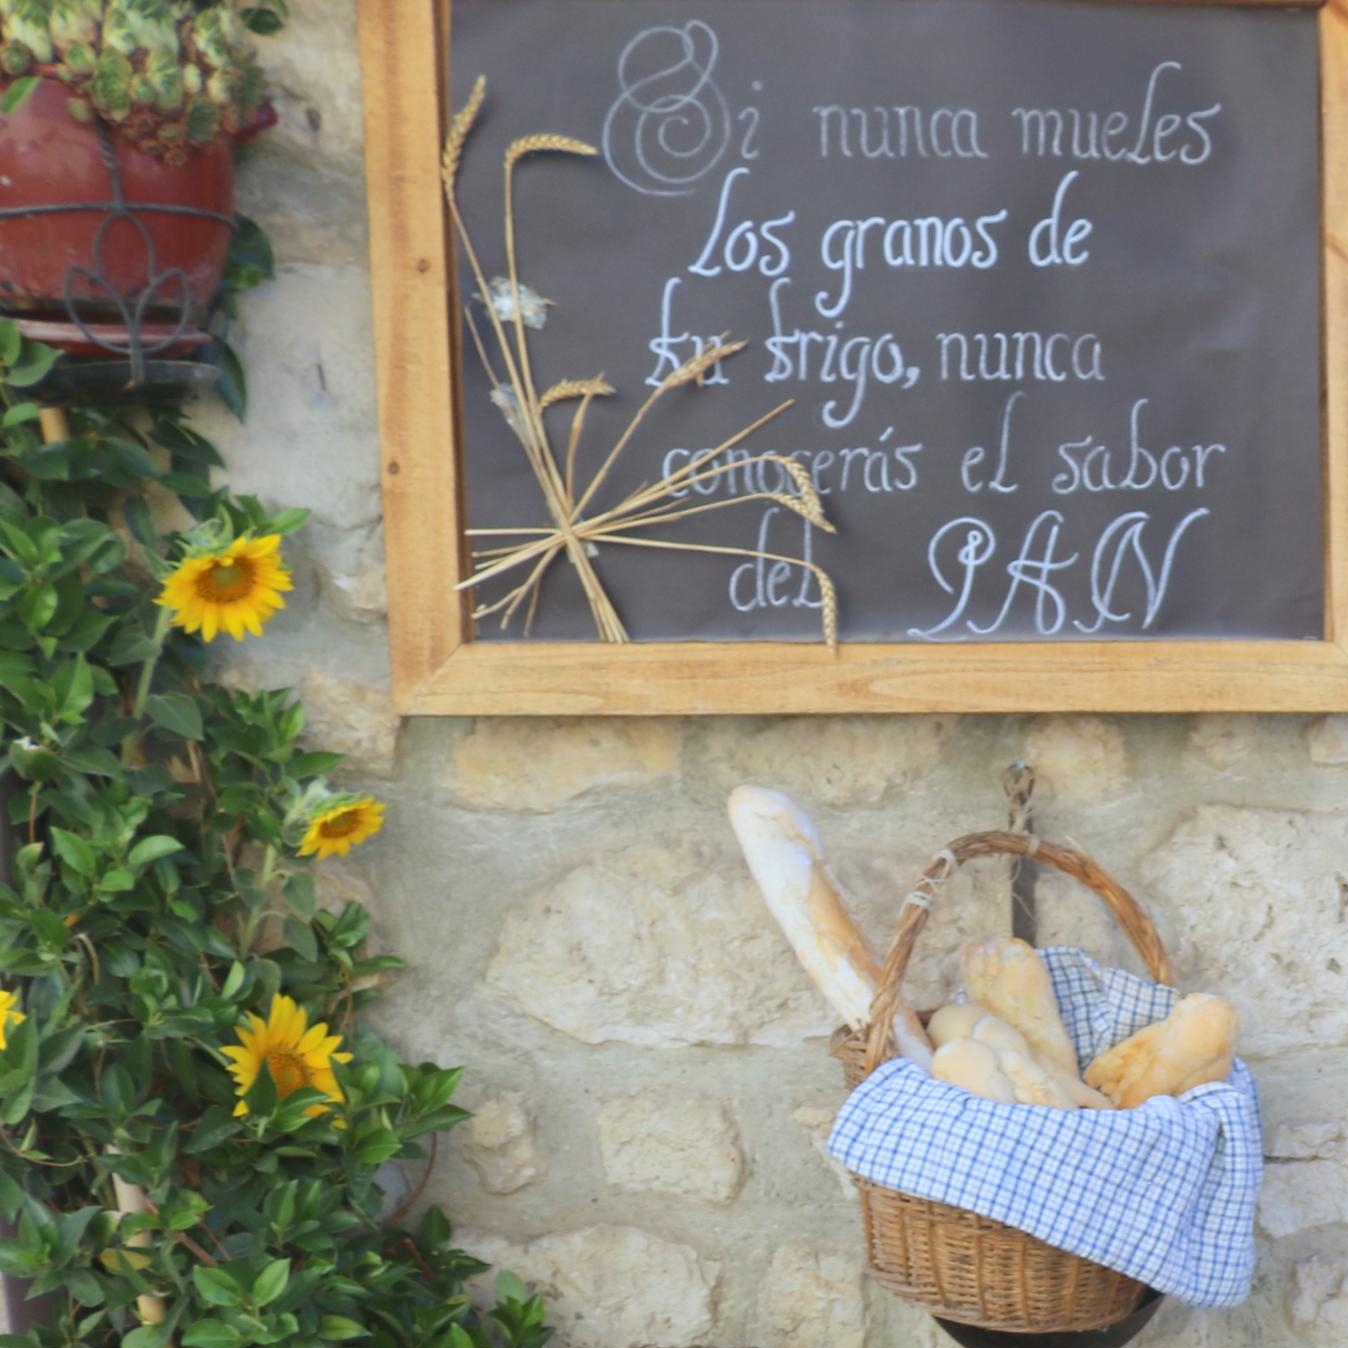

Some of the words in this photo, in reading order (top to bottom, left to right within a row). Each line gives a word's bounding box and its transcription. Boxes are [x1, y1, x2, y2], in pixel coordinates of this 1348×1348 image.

[604, 19, 762, 196] Si
[813, 104, 988, 160] nunca
[1010, 61, 1222, 166] mueles
[815, 208, 1007, 319] granos
[1028, 171, 1094, 268] de
[763, 277, 921, 428] trigo,
[936, 332, 1106, 383] nunca
[661, 426, 923, 497] conocerás
[961, 391, 1025, 493] el
[1051, 398, 1227, 495] sabor
[728, 507, 824, 612] del
[907, 508, 1211, 641] PAN
